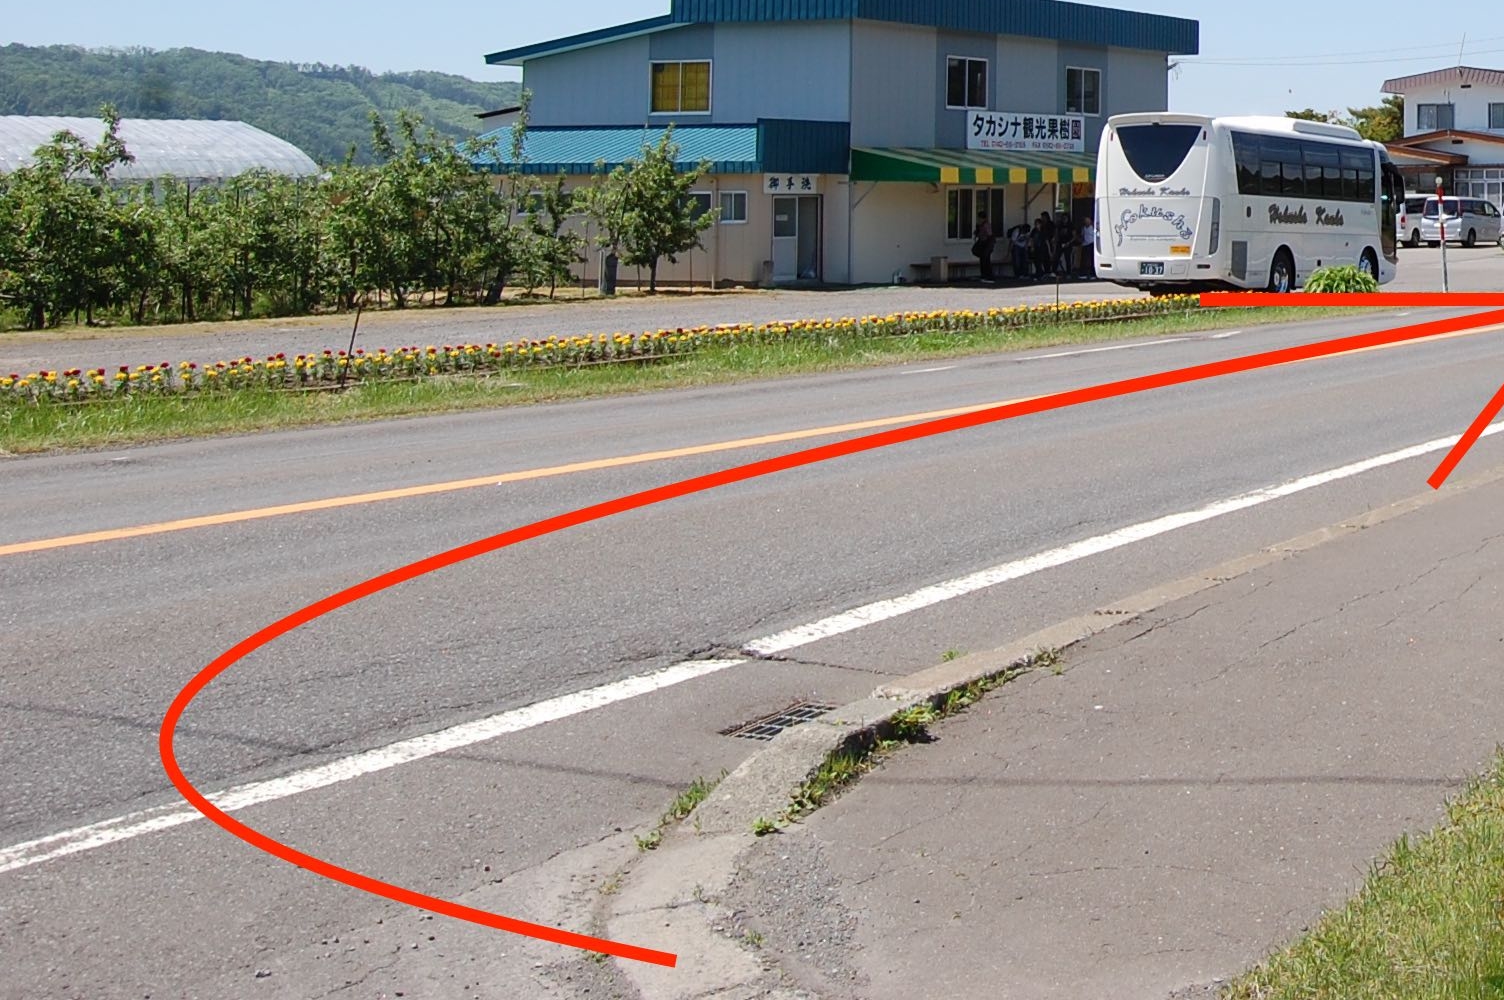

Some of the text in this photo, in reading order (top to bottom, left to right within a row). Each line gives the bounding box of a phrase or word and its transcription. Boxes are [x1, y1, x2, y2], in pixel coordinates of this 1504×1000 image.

[972, 113, 1082, 141] タカシナ観光果樹園
